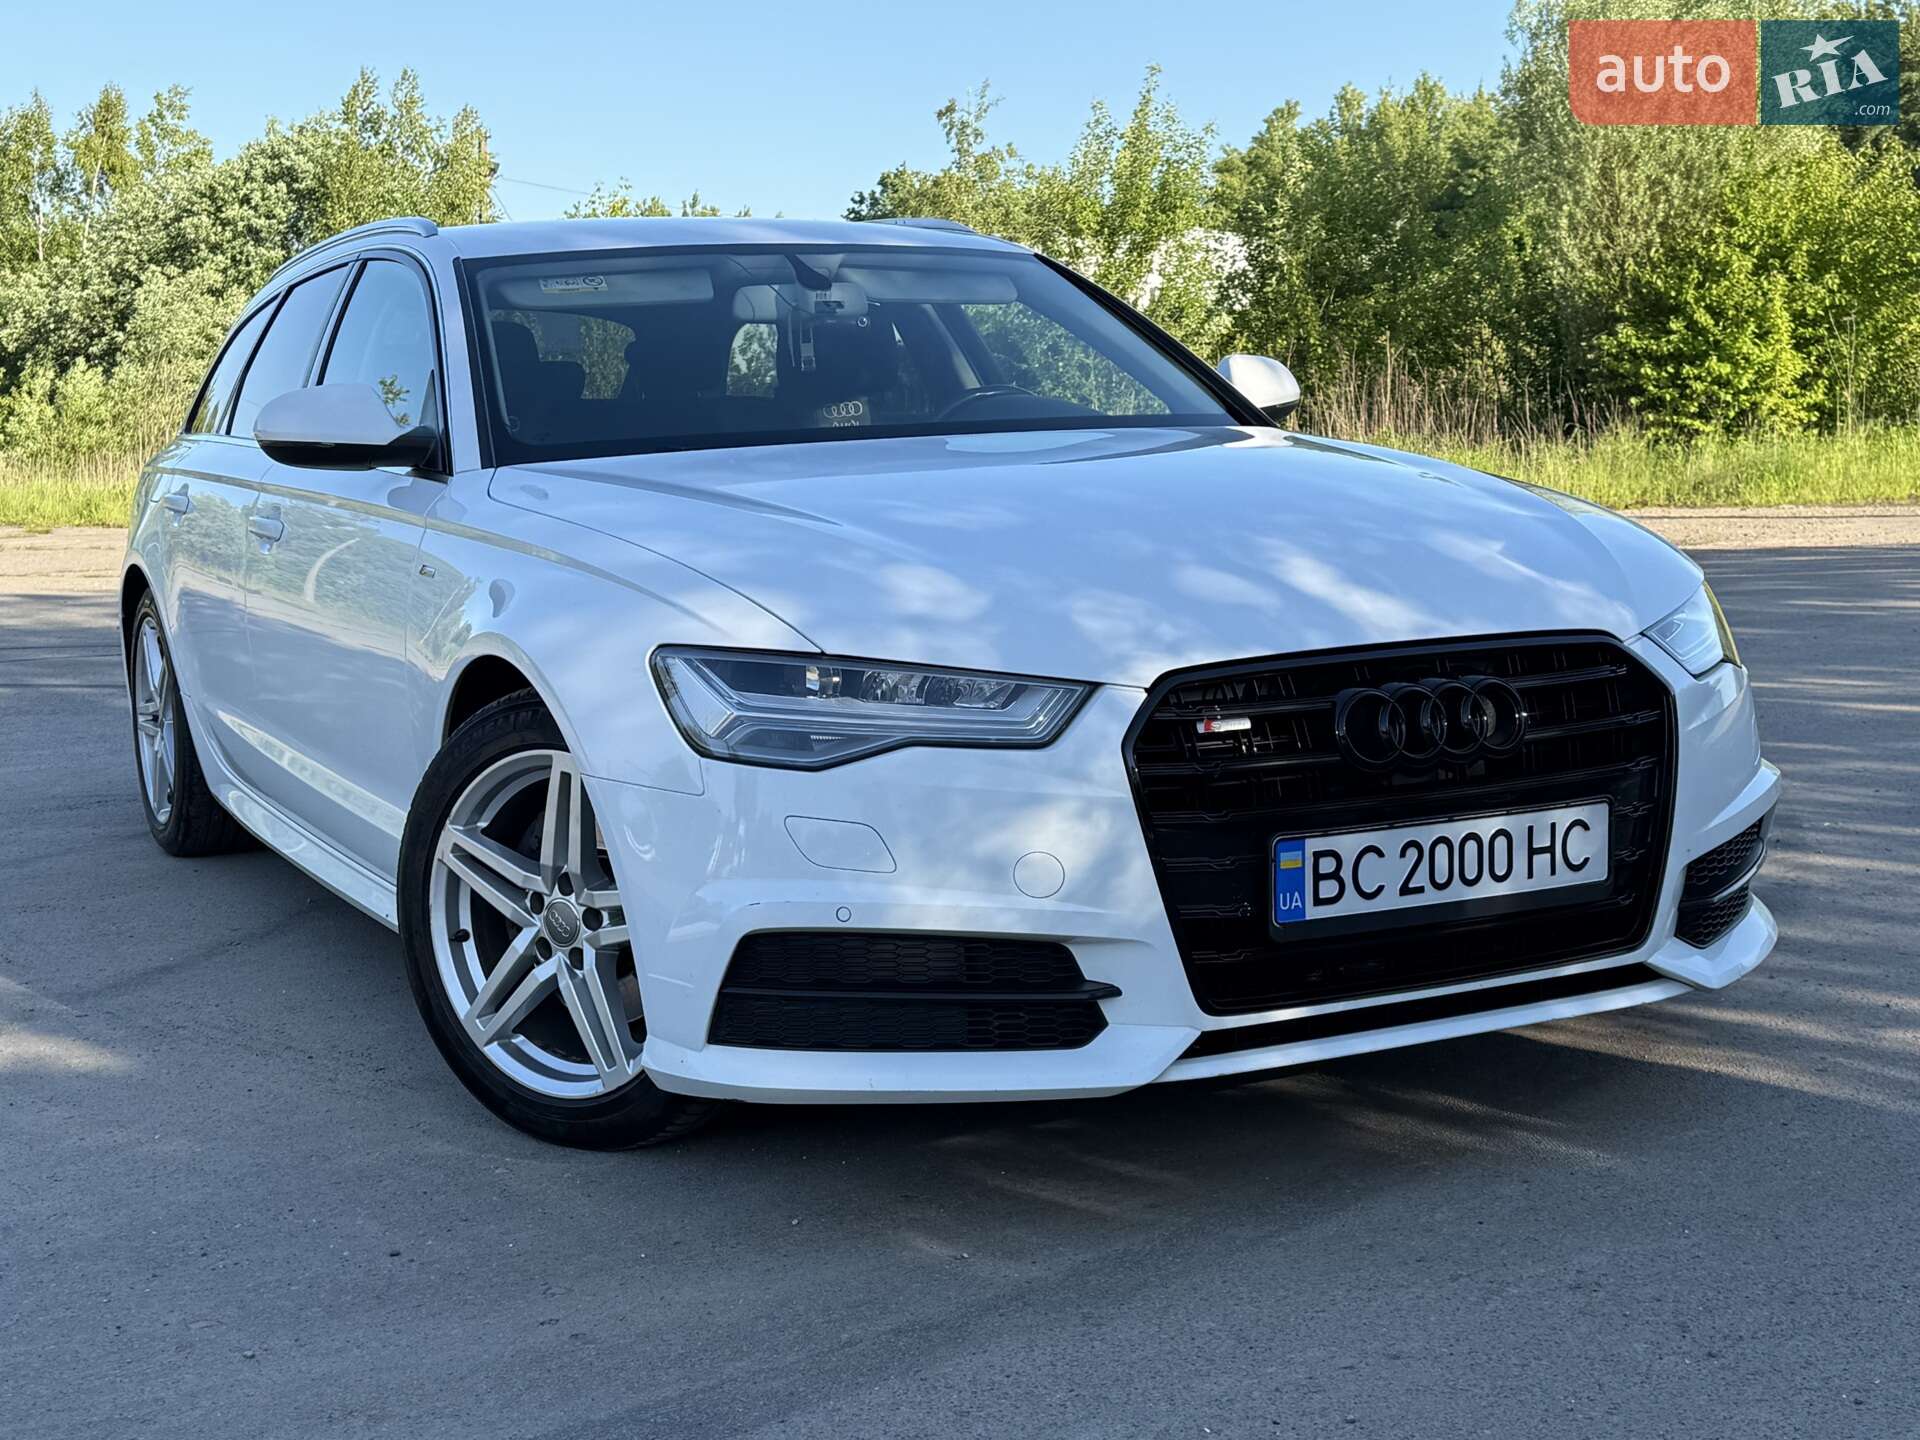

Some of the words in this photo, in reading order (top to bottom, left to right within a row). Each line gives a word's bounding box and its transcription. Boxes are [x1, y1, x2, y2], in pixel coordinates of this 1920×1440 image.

[1312, 844, 1386, 907] BC
[1398, 827, 1514, 897] 2000
[1527, 818, 1591, 881] HC
[1280, 890, 1303, 910] UA
